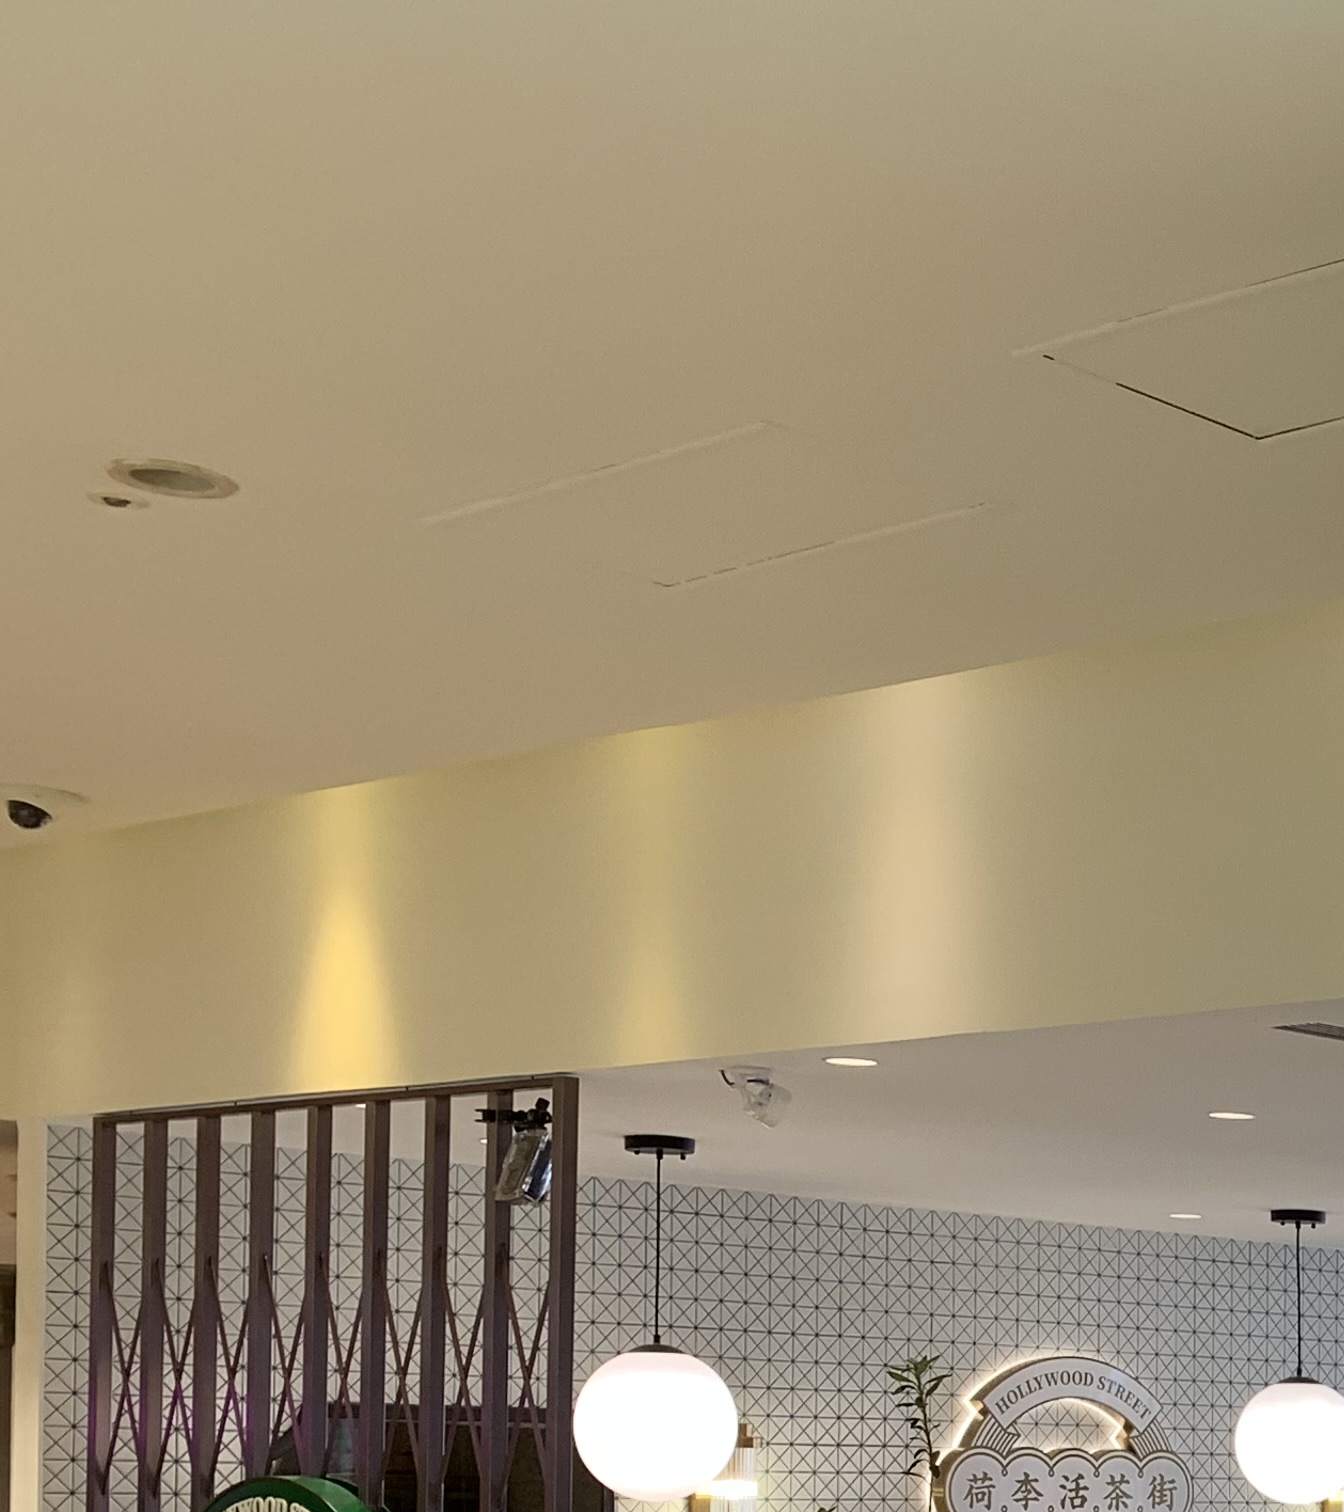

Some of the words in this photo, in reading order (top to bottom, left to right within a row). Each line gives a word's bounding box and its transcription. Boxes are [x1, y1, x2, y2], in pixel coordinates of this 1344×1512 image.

[994, 1370, 1094, 1415] HOLLYWOOD
[1097, 1375, 1152, 1420] STREET
[964, 1471, 1178, 1512] 荷李活茶街
